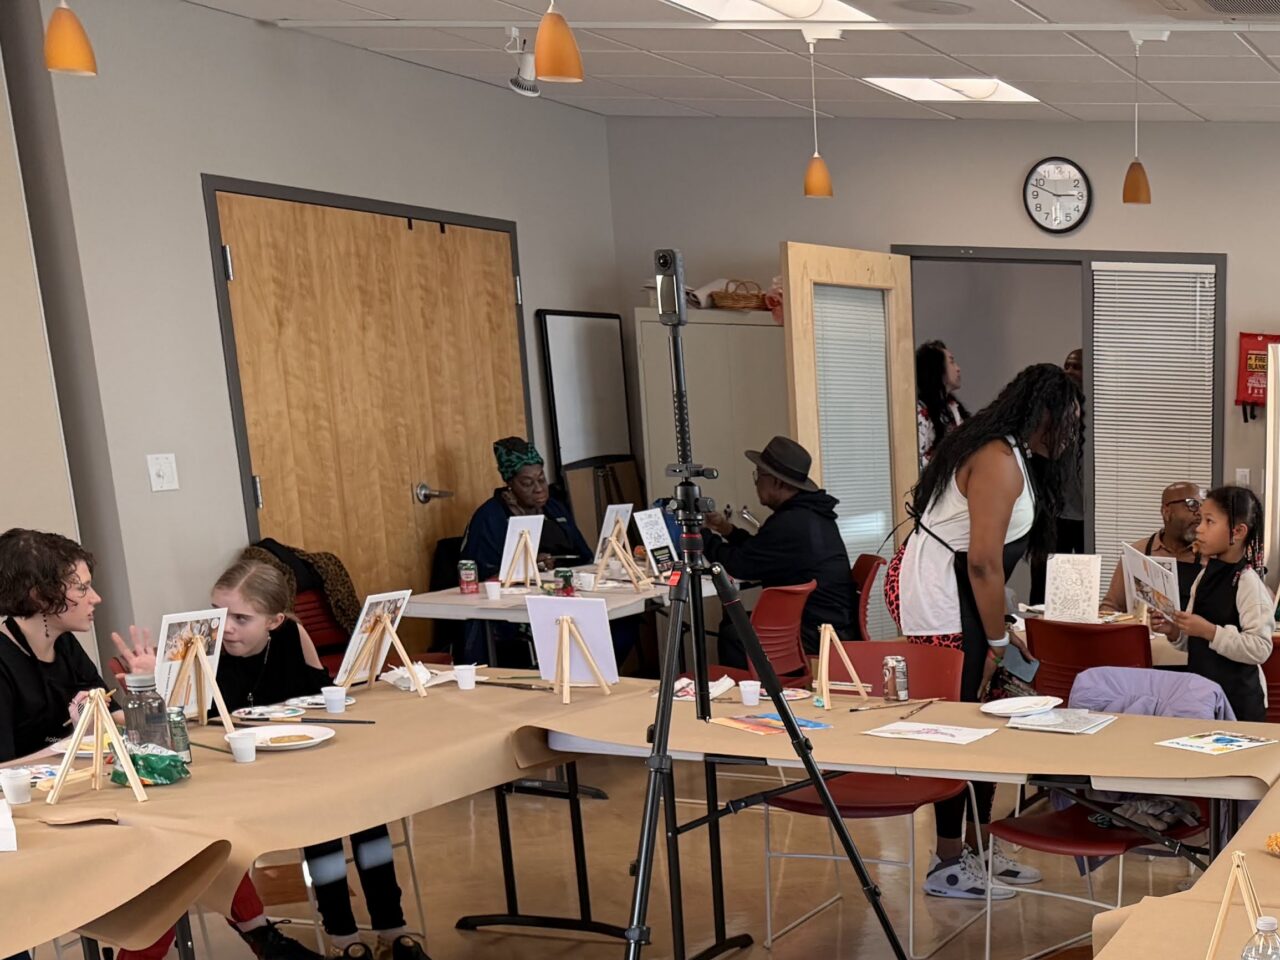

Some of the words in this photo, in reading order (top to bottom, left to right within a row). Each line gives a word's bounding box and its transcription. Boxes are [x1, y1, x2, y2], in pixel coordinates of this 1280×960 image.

[1035, 178, 1045, 187] 10
[1073, 179, 1079, 188] 2
[1032, 191, 1038, 199] 9
[1077, 192, 1083, 200] 3
[1035, 203, 1041, 212] 8
[1065, 213, 1071, 222] 5
[1254, 355, 1268, 363] FIRE
